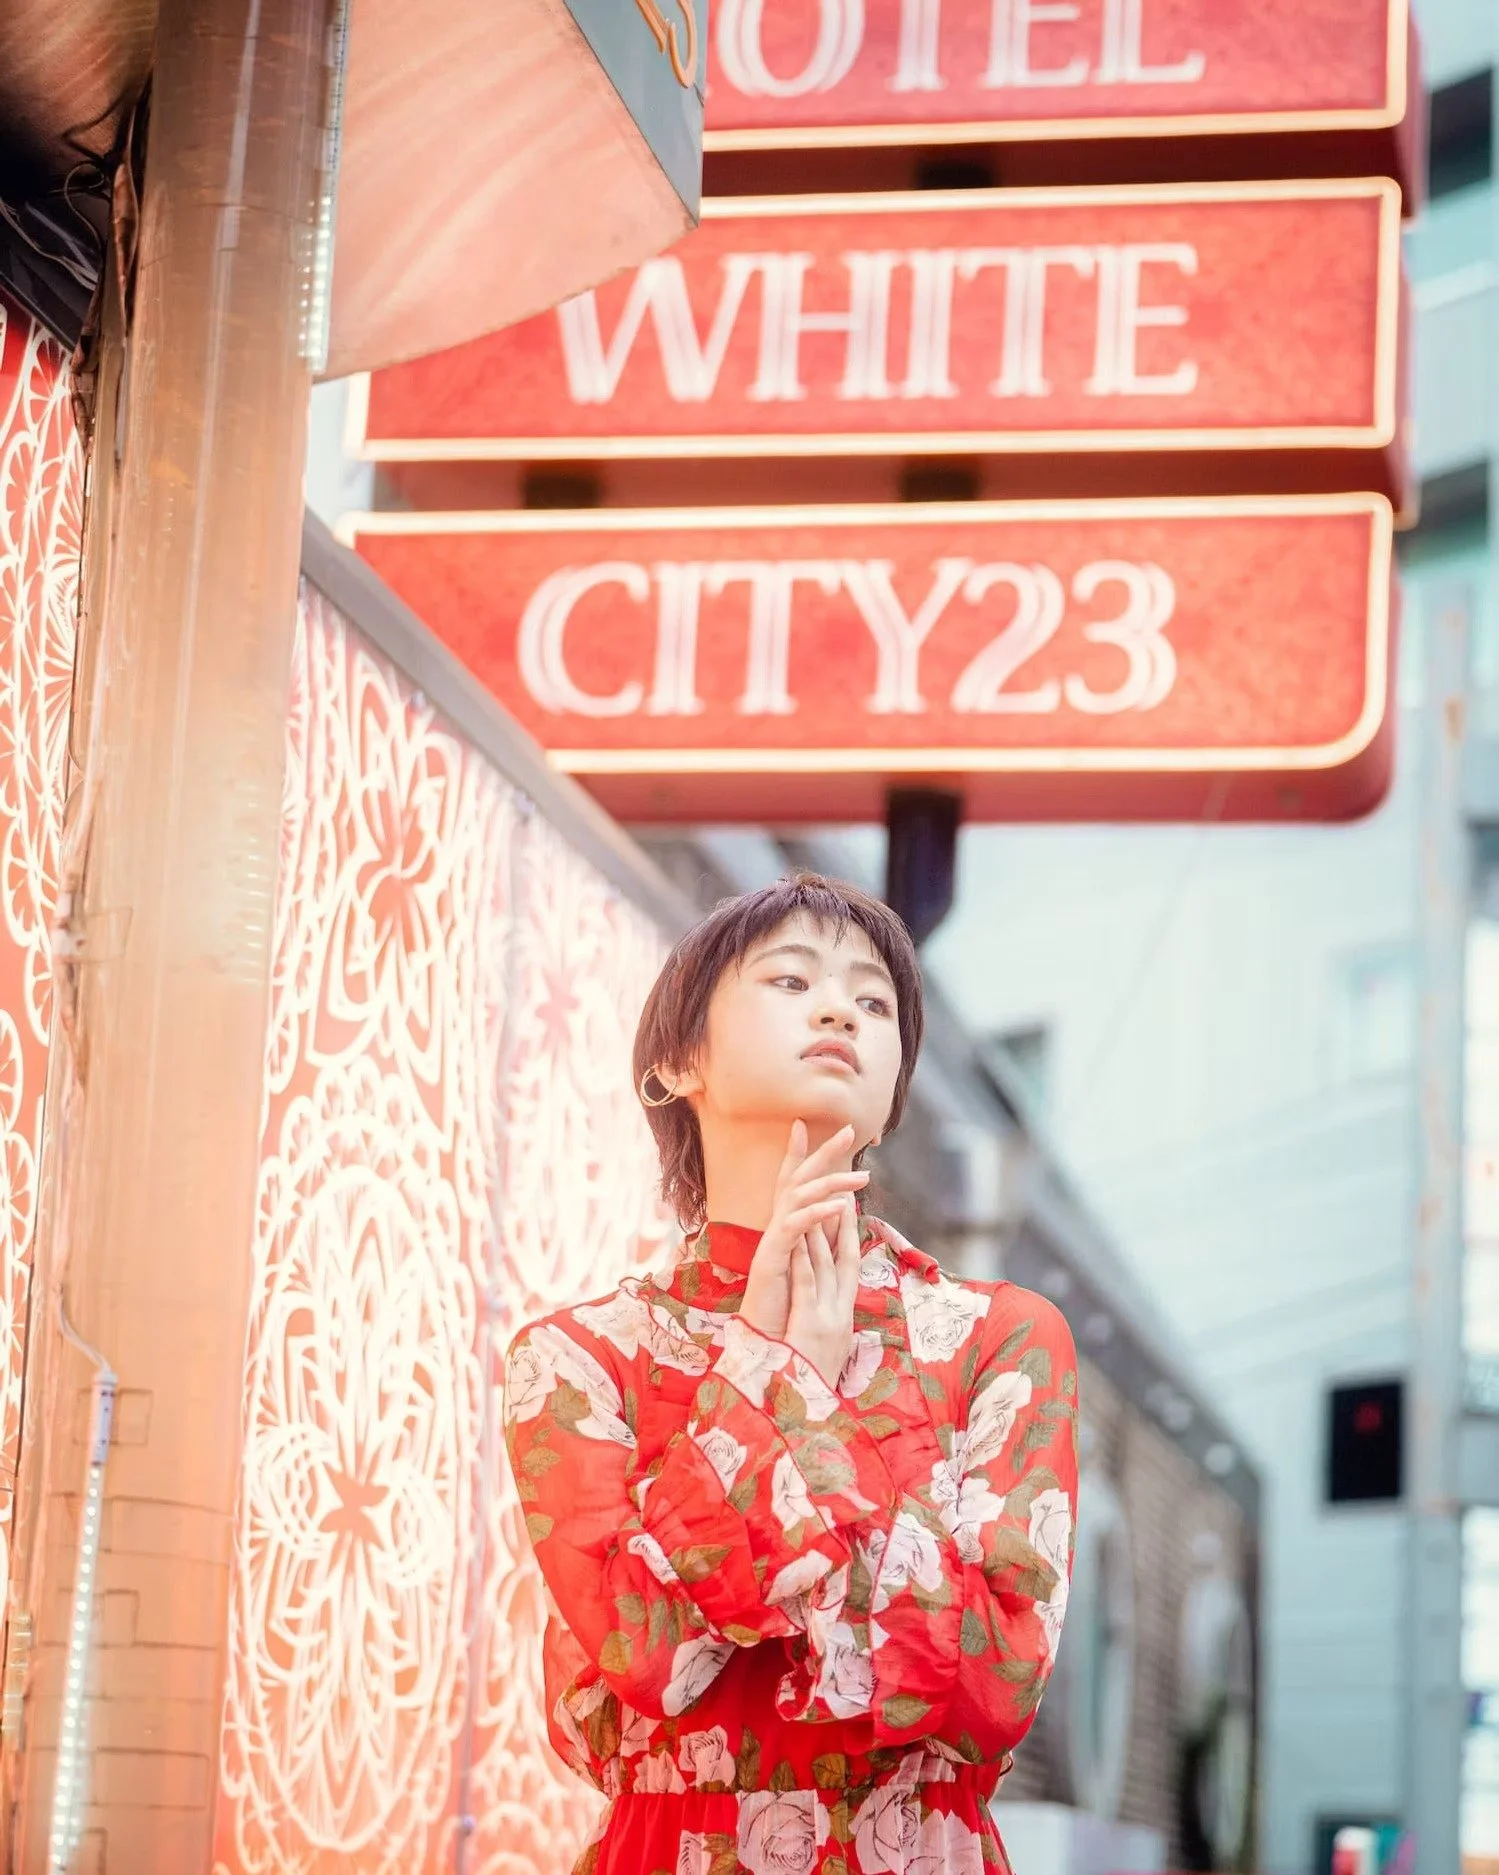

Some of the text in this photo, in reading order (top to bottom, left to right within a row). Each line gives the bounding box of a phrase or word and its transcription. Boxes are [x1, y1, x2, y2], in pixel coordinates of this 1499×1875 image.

[704, 0, 1205, 97] OTEL
[557, 244, 1199, 404] WHITE
[517, 558, 1178, 717] CITY23
